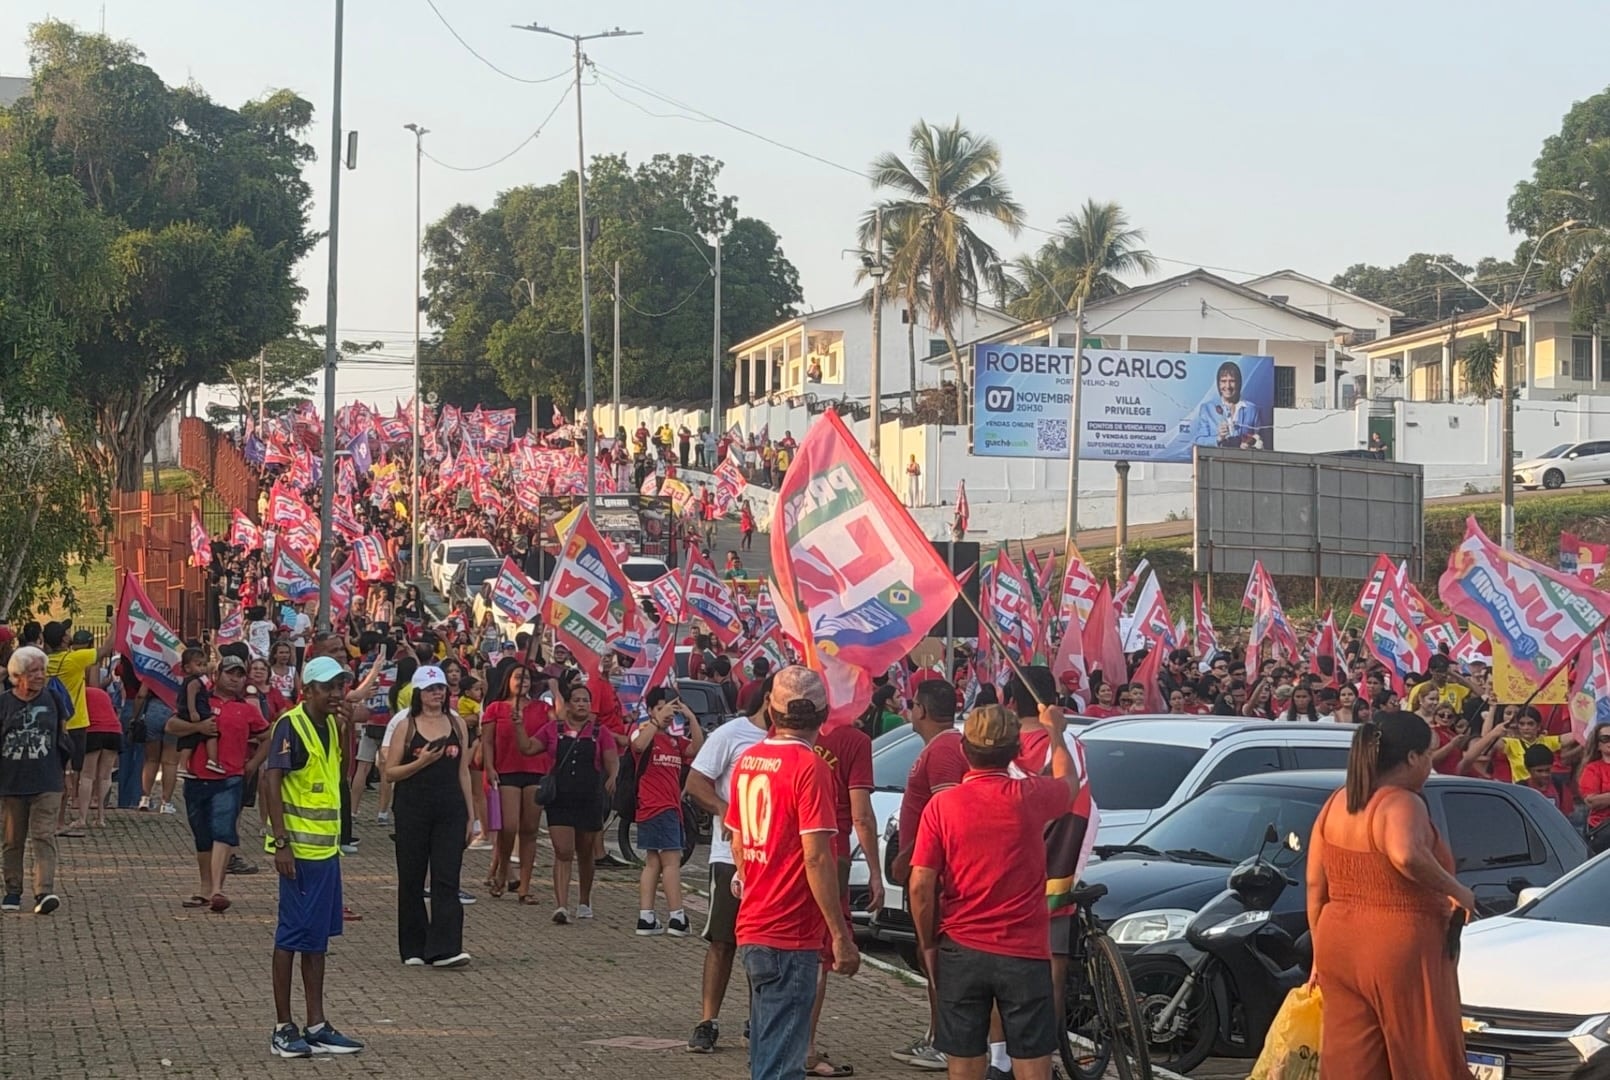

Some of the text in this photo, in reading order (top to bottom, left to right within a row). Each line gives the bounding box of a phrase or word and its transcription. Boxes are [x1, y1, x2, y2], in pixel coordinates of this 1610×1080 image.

[986, 352, 1187, 379] ROBERTO CARLOS
[988, 390, 1012, 409] 07
[1016, 404, 1043, 412] 20H30
[1116, 396, 1141, 405] VILLA
[1105, 406, 1152, 416] PRIVILEGE
[741, 755, 782, 773] COUTINHO
[737, 773, 772, 847] 10
